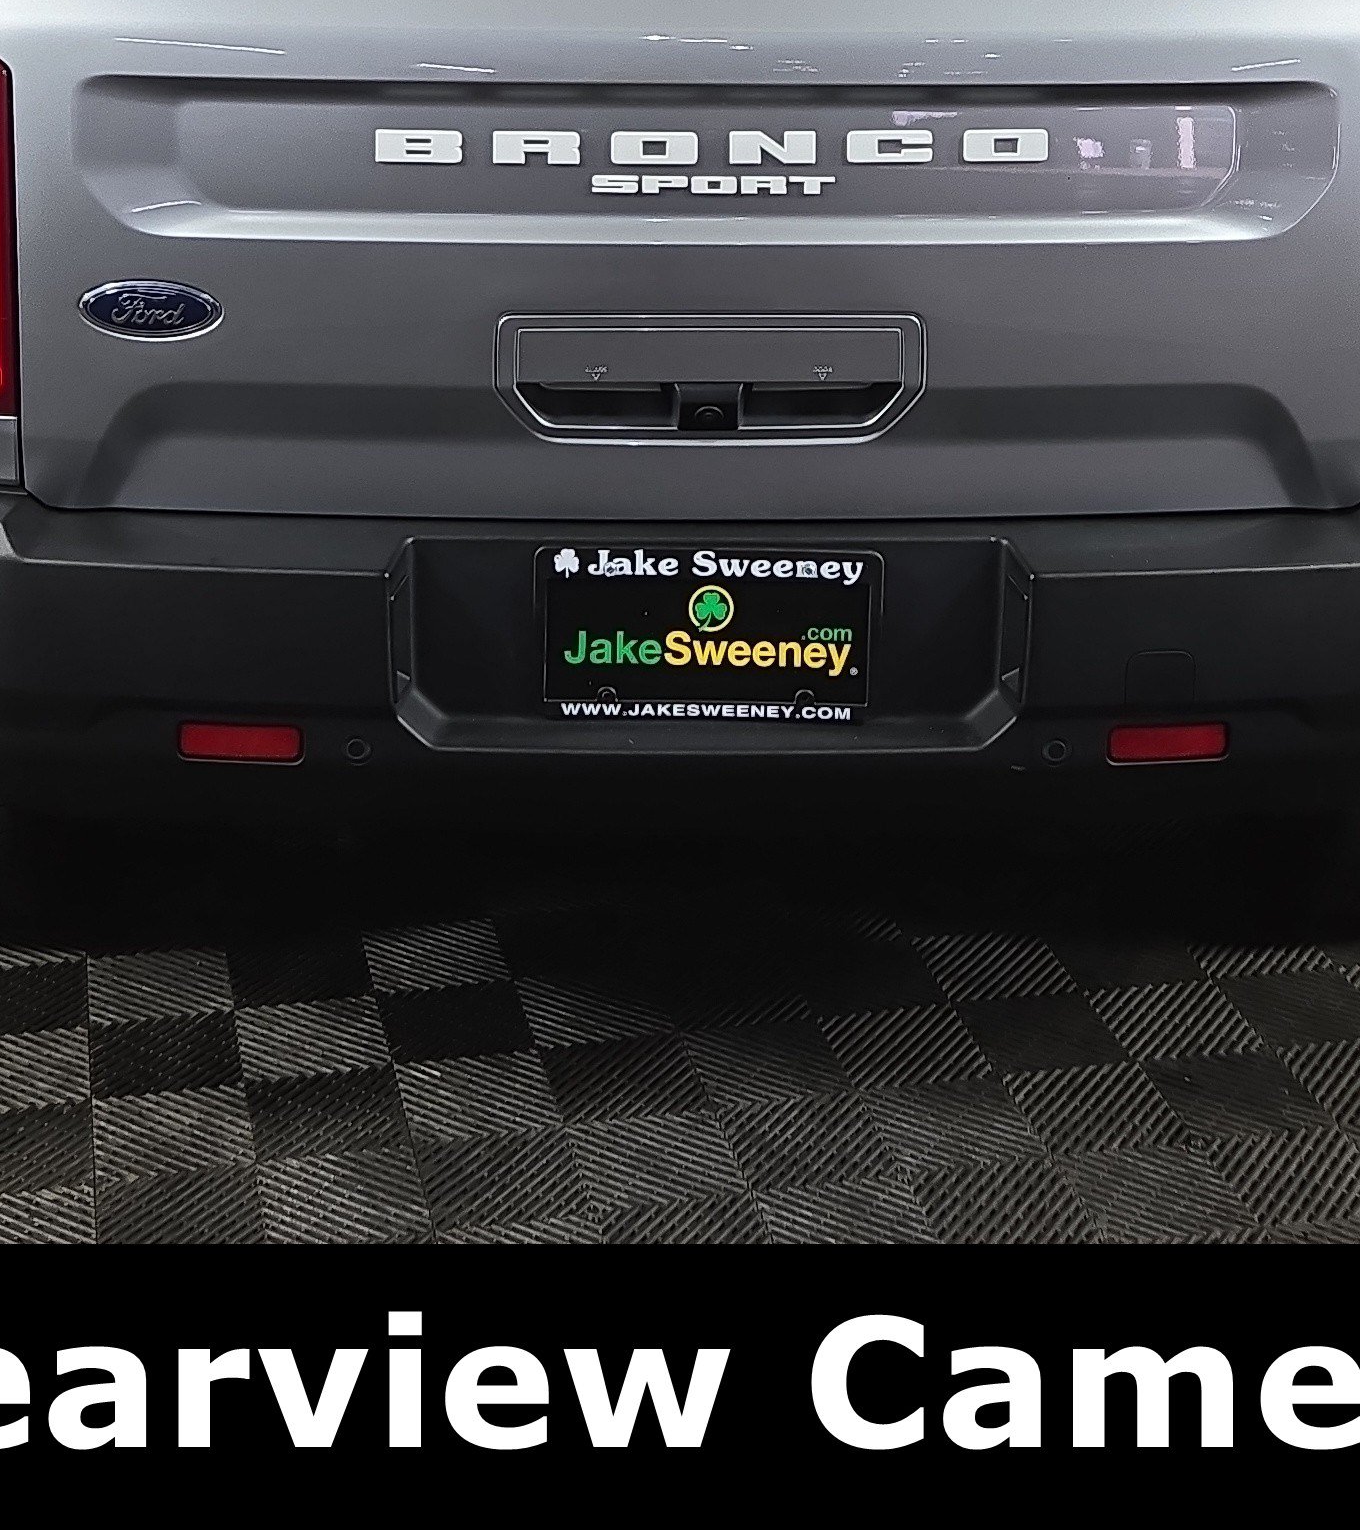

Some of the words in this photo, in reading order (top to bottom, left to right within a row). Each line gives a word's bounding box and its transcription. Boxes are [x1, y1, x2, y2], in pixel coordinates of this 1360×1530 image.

[375, 128, 1049, 165] BRONCO
[591, 175, 836, 195] SPORT
[111, 293, 186, 325] Ford
[587, 549, 679, 577] Jake
[691, 550, 864, 585] Sweeney
[561, 702, 851, 721] WWW.JAKESWEENEY.COM
